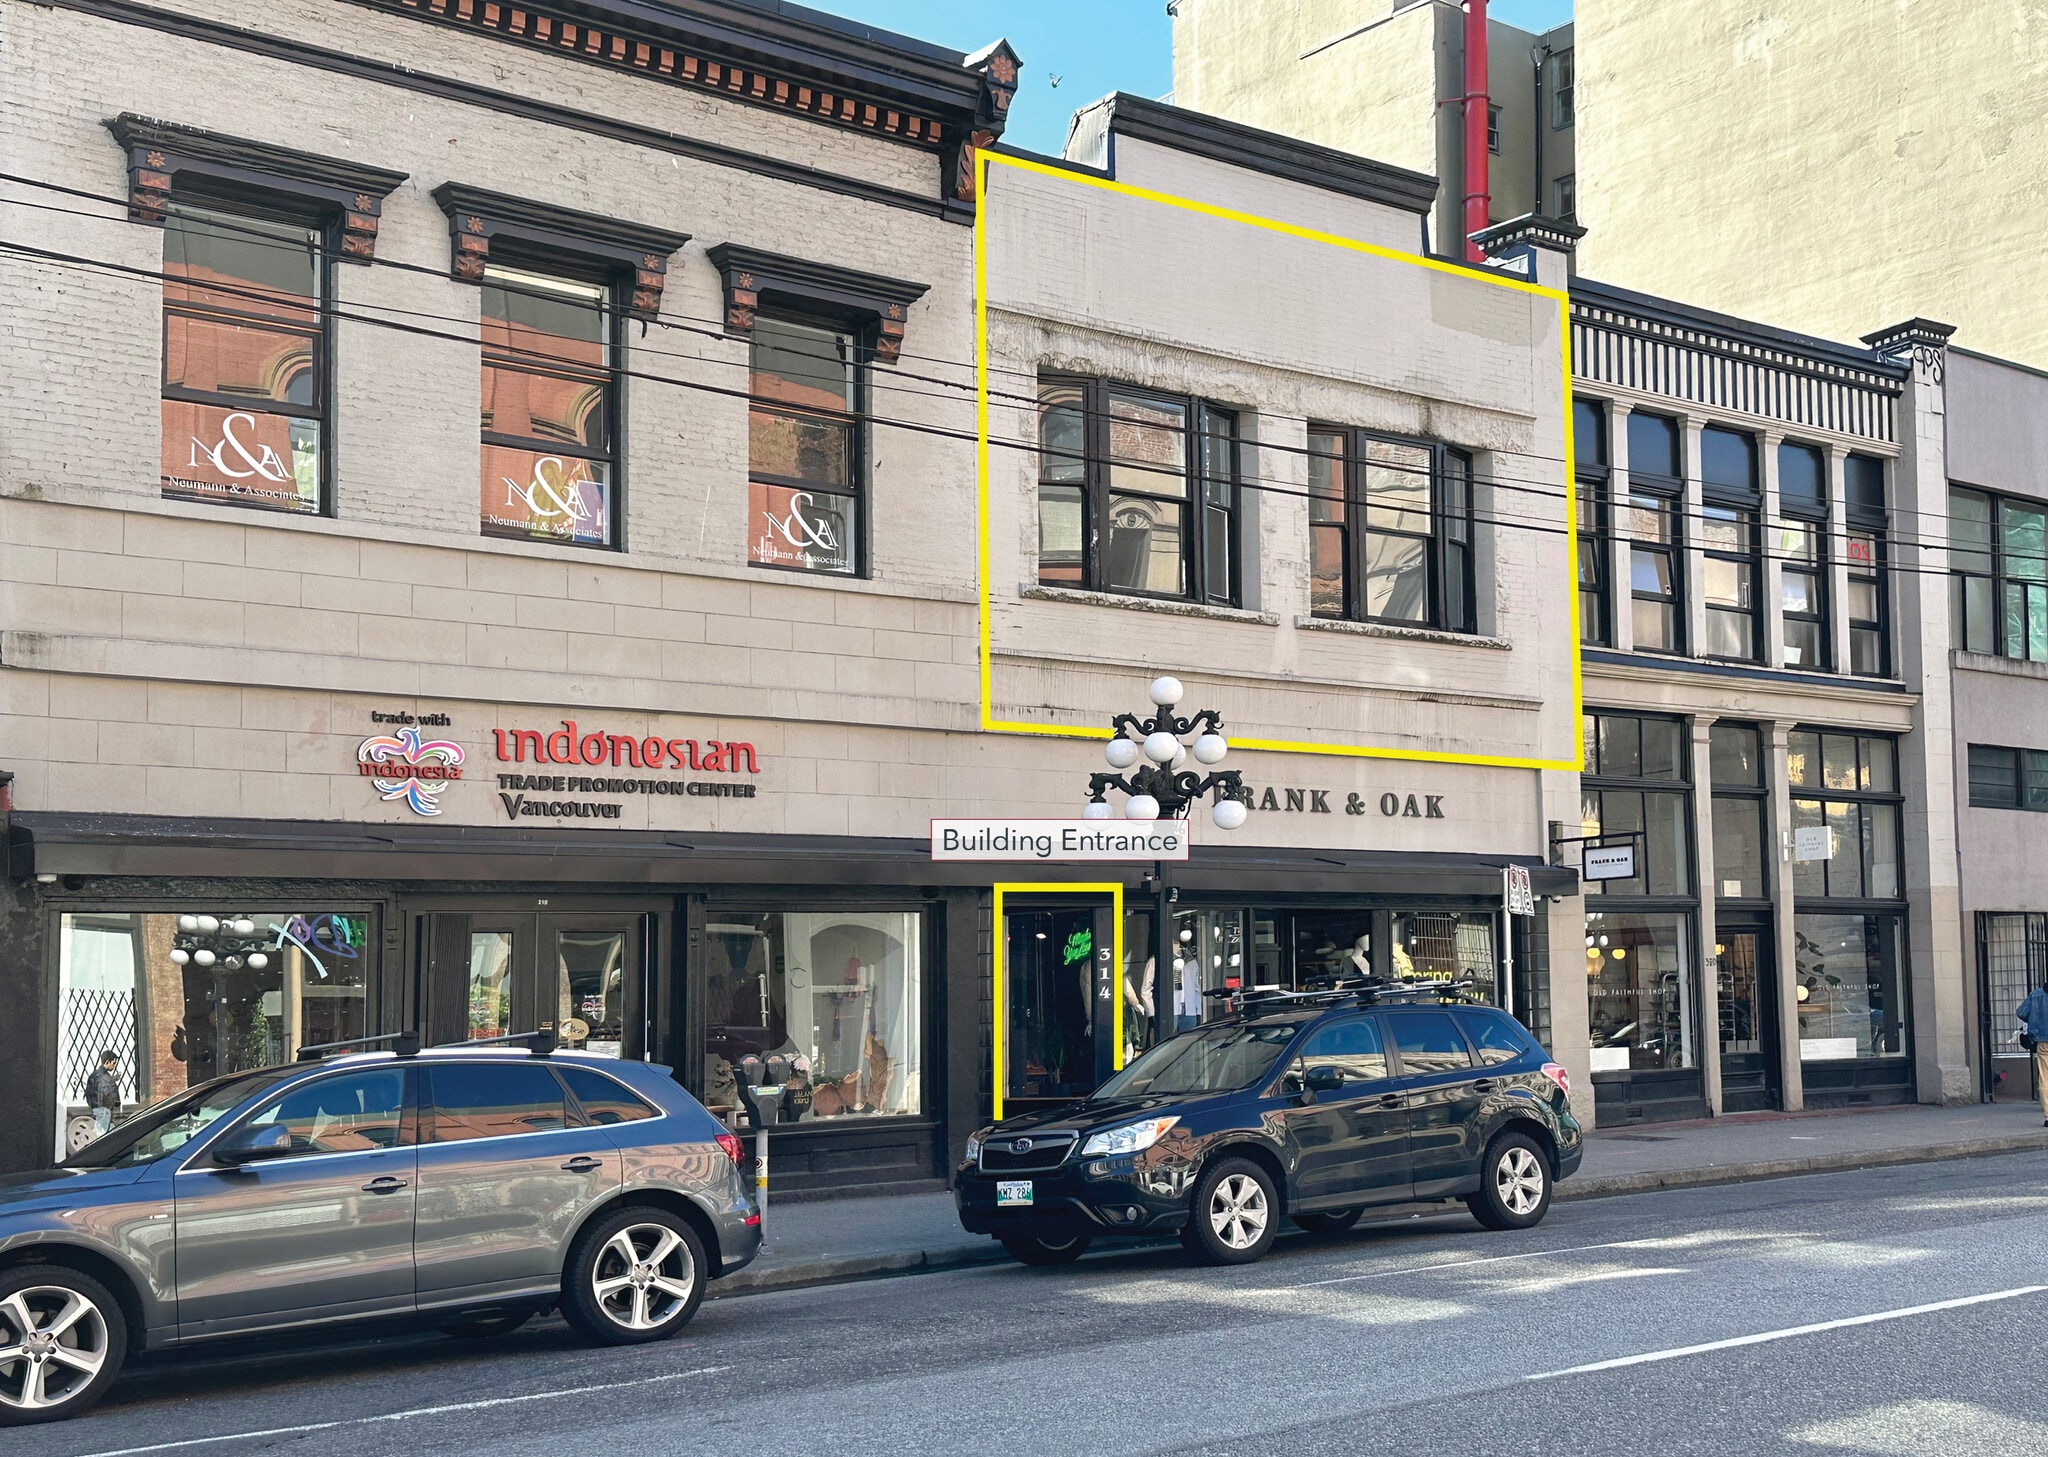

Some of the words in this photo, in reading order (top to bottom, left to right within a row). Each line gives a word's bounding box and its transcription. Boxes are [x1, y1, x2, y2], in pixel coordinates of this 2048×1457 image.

[169, 475, 226, 493] Neumann
[229, 482, 241, 495] &
[501, 456, 593, 521] N&A
[489, 514, 538, 530] Neumann
[762, 492, 840, 551] N&A
[371, 711, 415, 725] trade
[418, 713, 451, 726] with
[492, 720, 761, 773] indonesian
[498, 773, 566, 792] TRADE
[568, 776, 686, 797] PROMOTION
[687, 782, 757, 798] CENTER
[499, 792, 623, 820] Vancouver
[1345, 792, 1366, 816] &
[1380, 793, 1445, 818] OAK
[1098, 947, 1112, 999] 314
